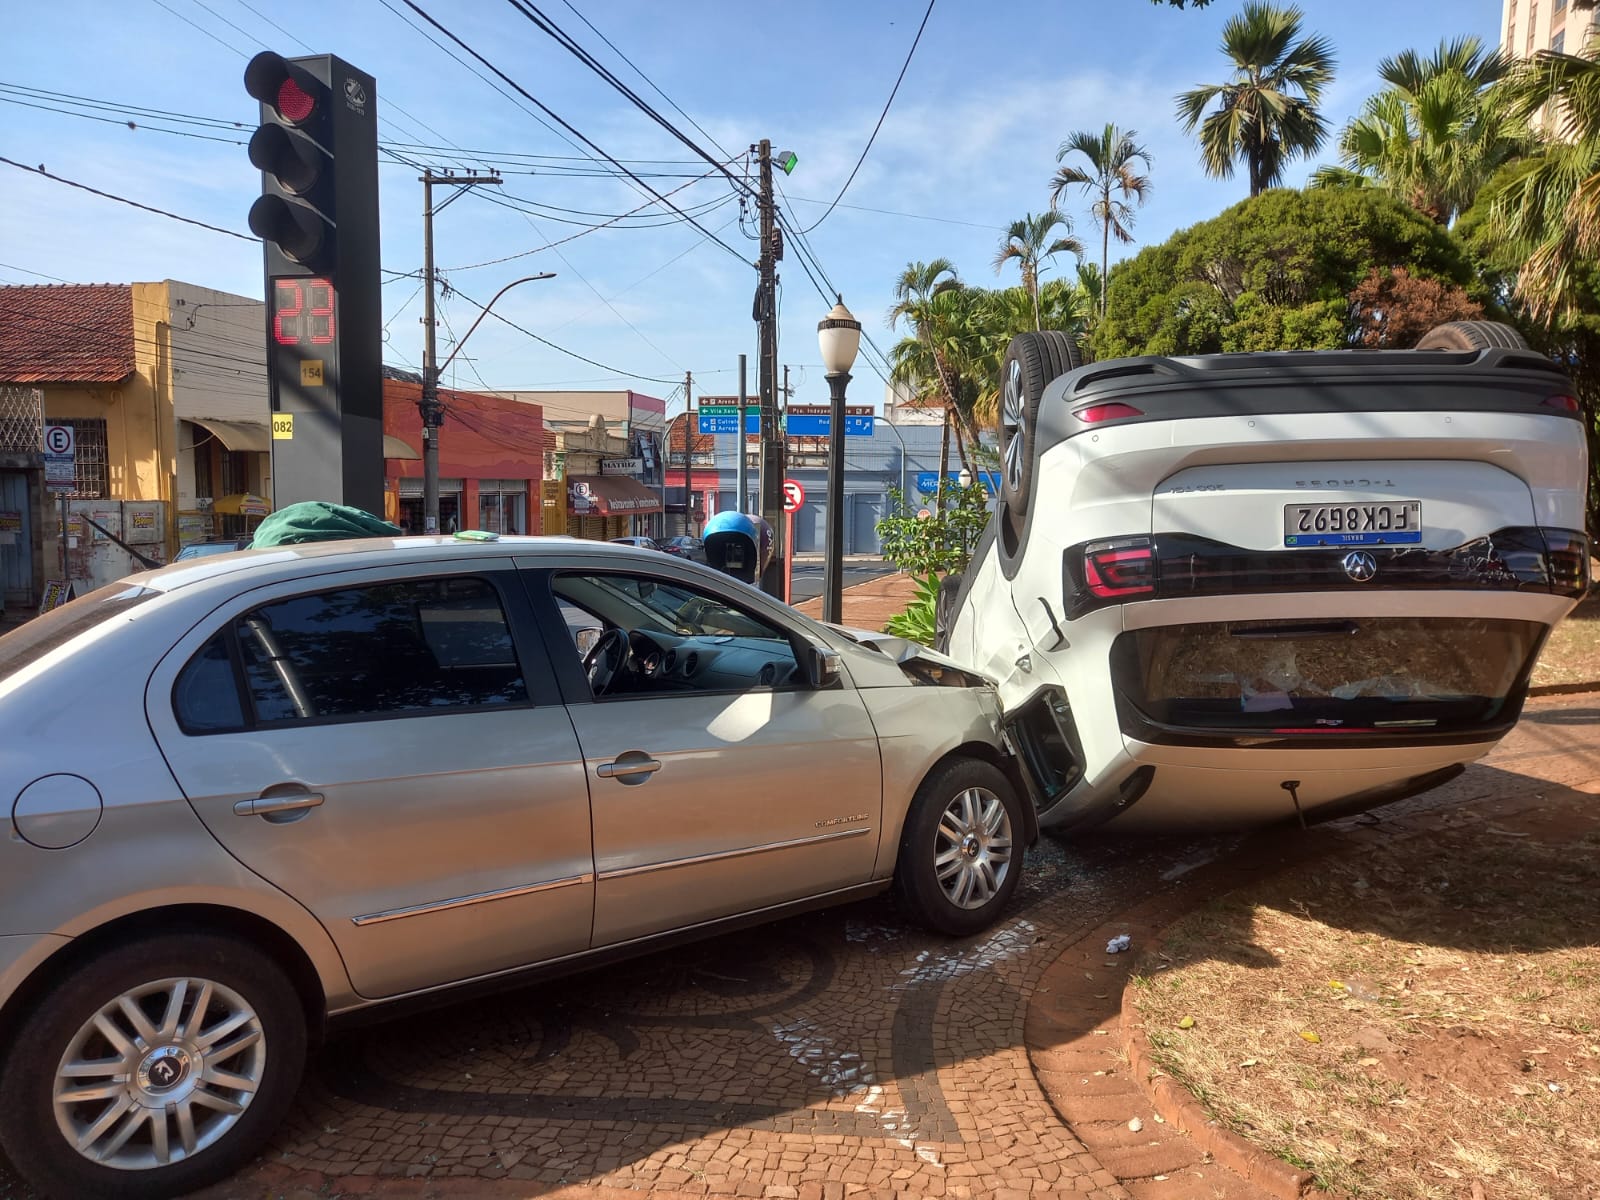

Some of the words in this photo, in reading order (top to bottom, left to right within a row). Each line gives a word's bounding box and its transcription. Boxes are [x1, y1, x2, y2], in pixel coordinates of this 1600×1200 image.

[274, 279, 336, 344] 23
[302, 368, 321, 379] 154
[273, 421, 293, 433] 082
[53, 432, 63, 448] E
[579, 485, 585, 494] E
[1294, 479, 1396, 488] T-CROSS
[1298, 506, 1408, 532] FCK8G92
[1342, 534, 1364, 542] BRASIL
[814, 813, 869, 828] COMFORTLINE
